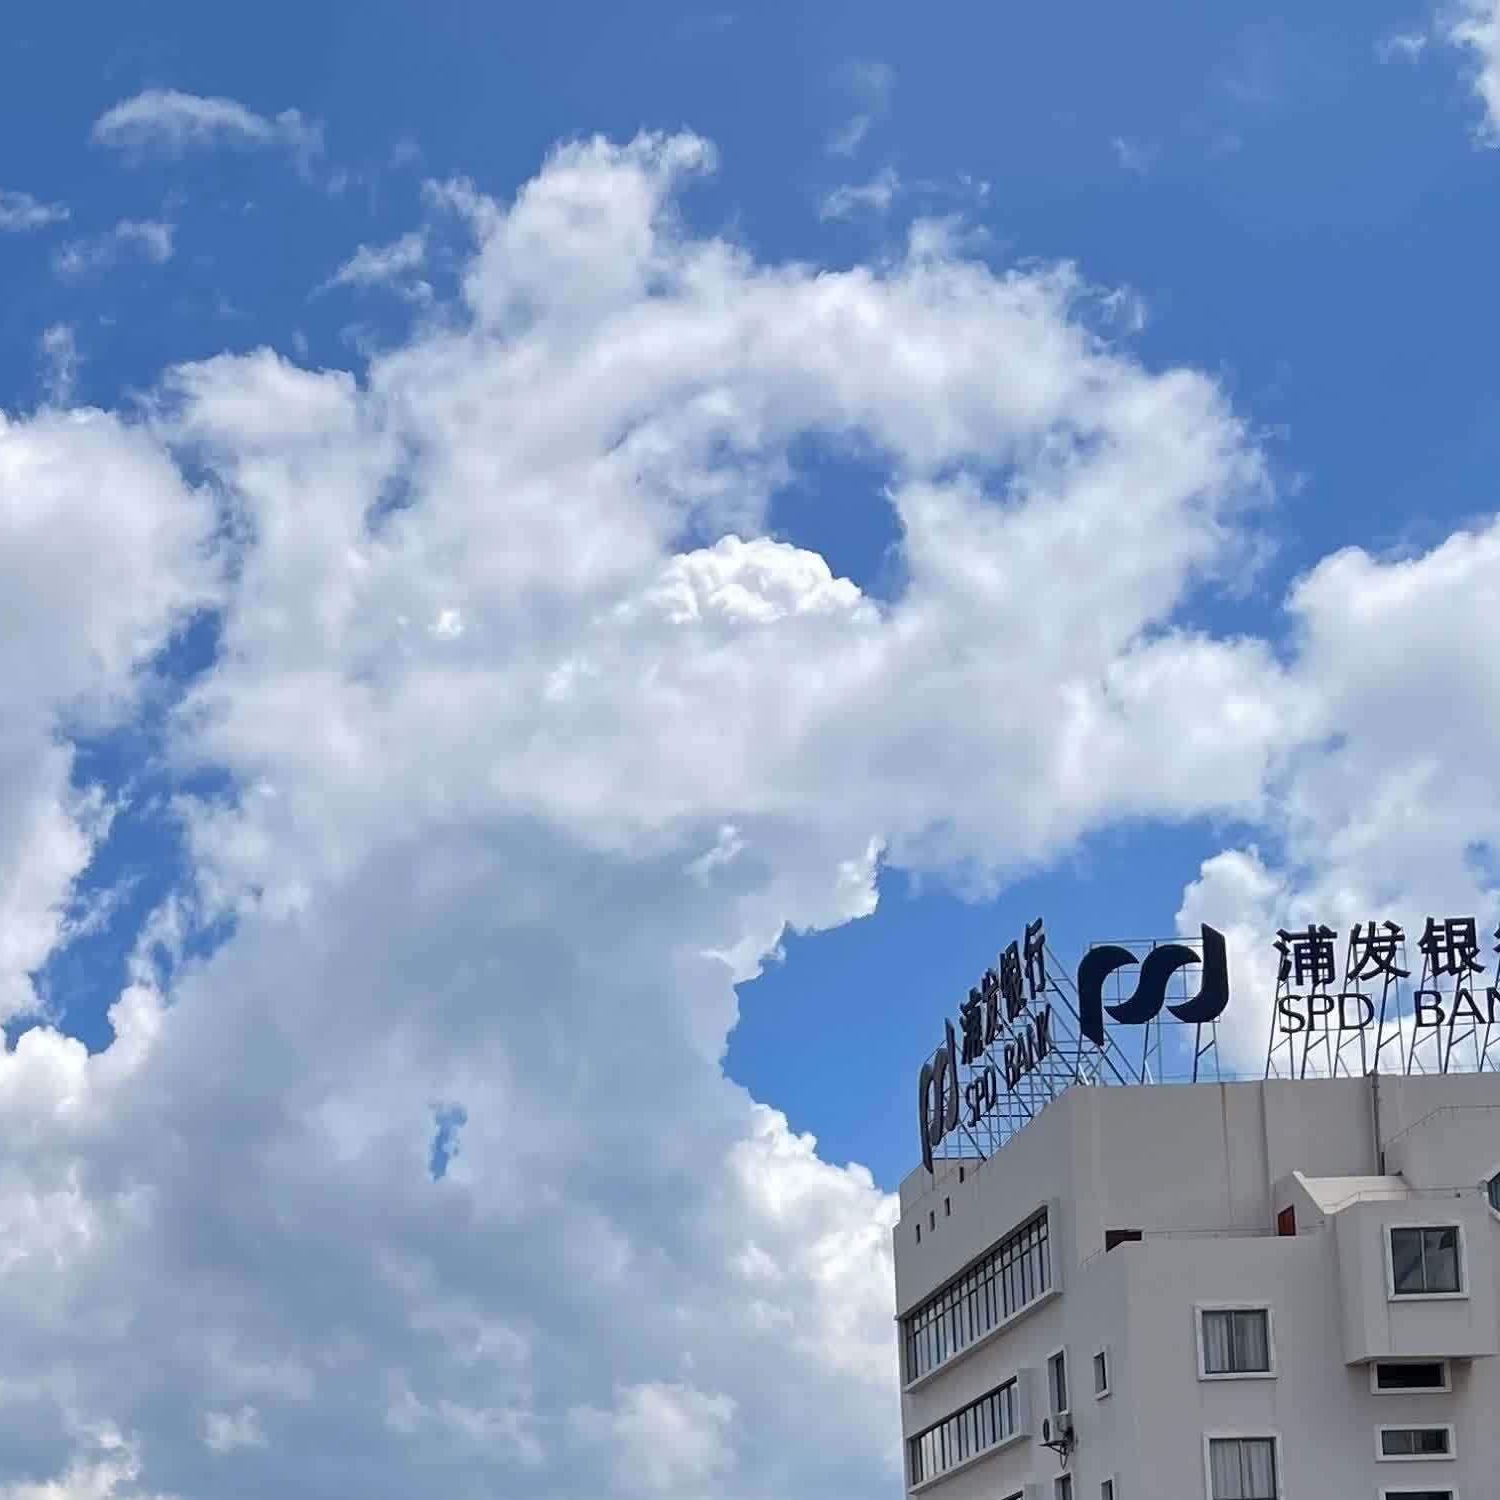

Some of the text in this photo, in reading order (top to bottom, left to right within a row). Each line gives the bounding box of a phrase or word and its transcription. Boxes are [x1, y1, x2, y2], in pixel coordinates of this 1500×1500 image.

[1272, 917, 1500, 986] 浦发银
[1278, 993, 1375, 1033] SPD
[965, 1003, 1052, 1128] SPD BANK
